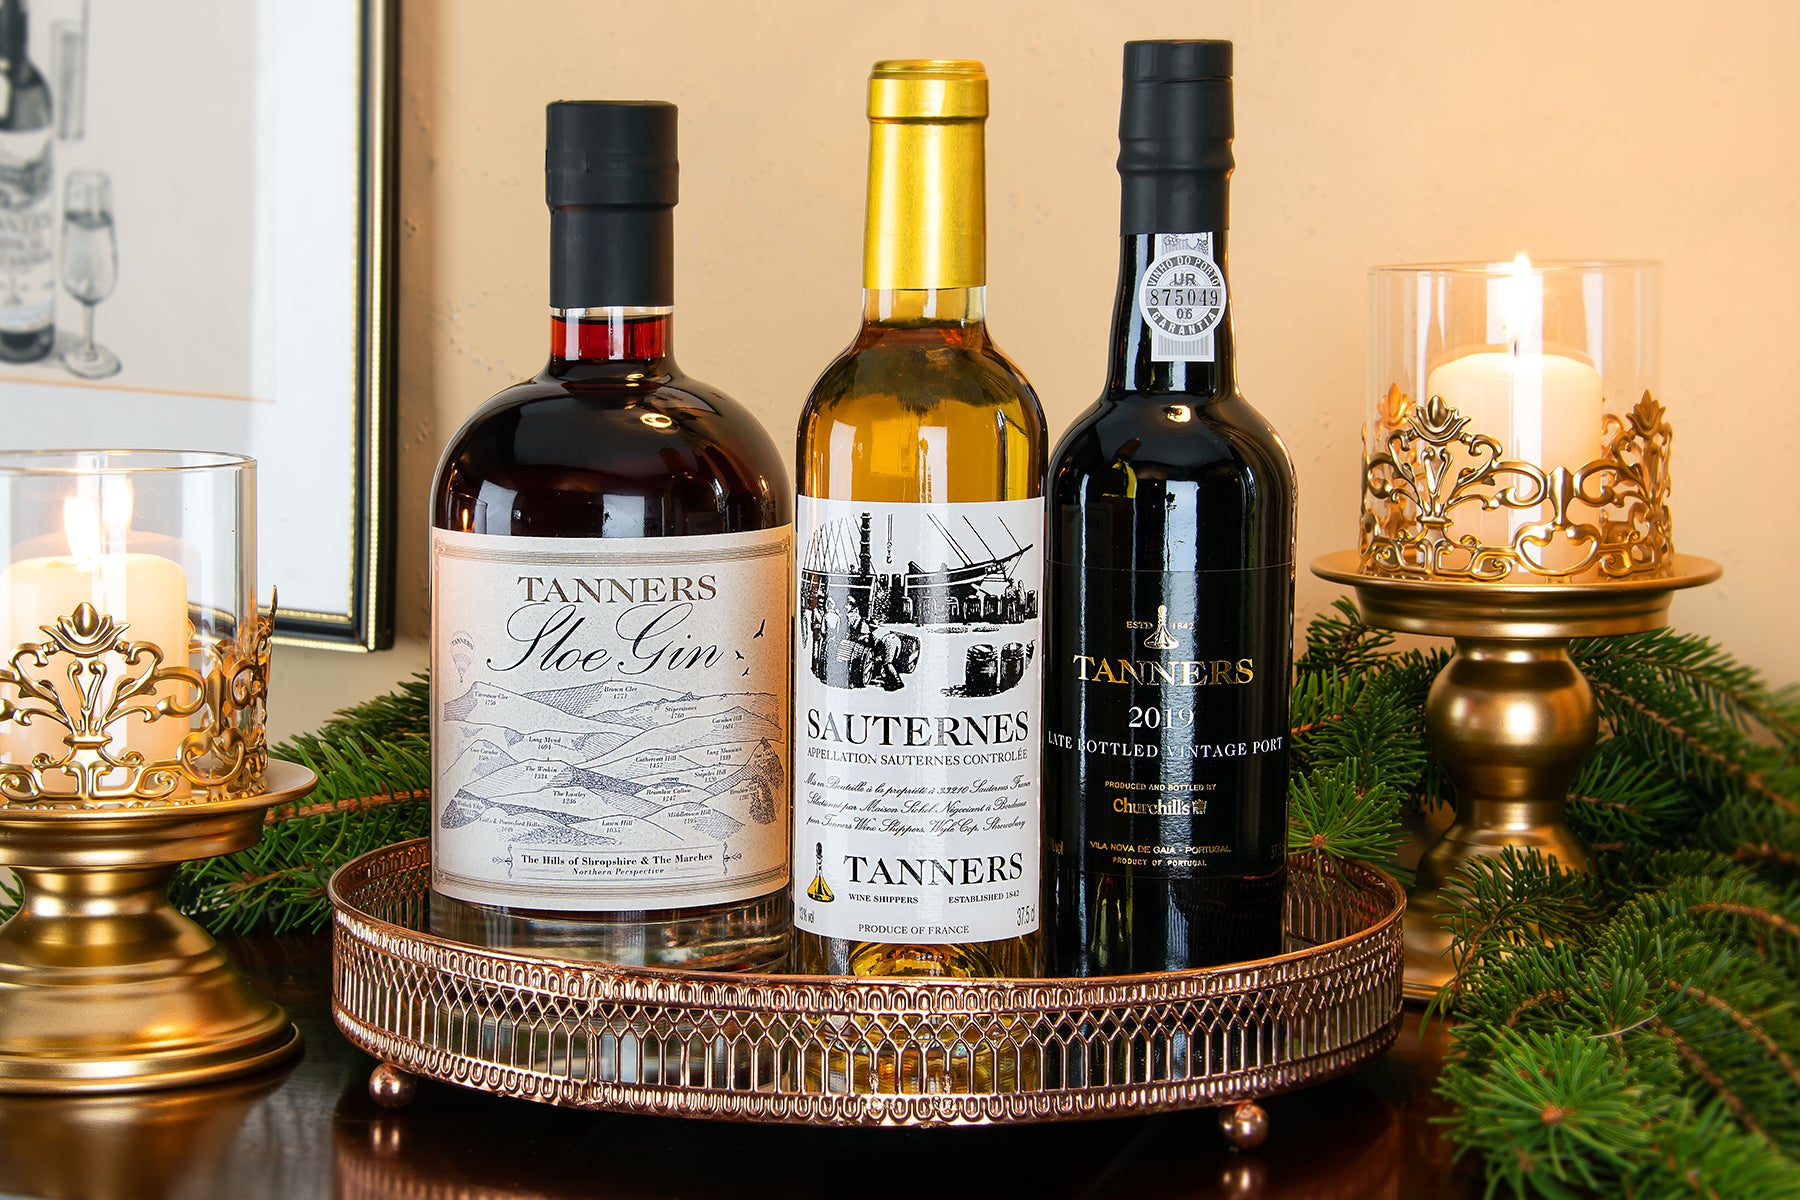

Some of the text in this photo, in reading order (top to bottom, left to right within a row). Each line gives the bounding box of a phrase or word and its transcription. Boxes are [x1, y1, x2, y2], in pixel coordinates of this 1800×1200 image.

[1147, 256, 1220, 286] VINHO DO PORTO
[1174, 273, 1196, 285] UR
[1150, 289, 1218, 306] 875049
[1152, 311, 1217, 335] GARANTIA
[517, 574, 717, 604] TANNERS
[1171, 622, 1195, 630] 1842
[486, 603, 724, 675] Sloe Gin
[1072, 654, 1254, 686] TANNERS
[1128, 706, 1194, 729] 2019
[807, 708, 1029, 746] SAUTERNES
[1048, 730, 1282, 758] LATE BOTTLED VINTAGE PORT
[807, 747, 1028, 766] APPELLATION SAUTERNES CONTROLÉE
[804, 772, 816, 786] Mis
[826, 776, 868, 792] Bouteille
[866, 785, 873, 793] à
[875, 782, 887, 793] la
[882, 786, 928, 798] propriété
[970, 779, 1008, 794] Sauternes
[1105, 781, 1147, 791] PRODUCED
[1149, 783, 1166, 791] AND
[1206, 783, 1217, 791] BY
[839, 803, 858, 813] par
[859, 799, 899, 812] Maison
[901, 800, 940, 814] Sichel
[935, 800, 985, 817] Négociant
[1113, 797, 1191, 816] Churchill's
[821, 814, 852, 829] Tanners
[854, 817, 877, 831] Wine
[1090, 841, 1108, 851] VILA
[1110, 843, 1135, 853] NOVA
[1137, 845, 1151, 854] DE
[1153, 846, 1177, 854] GAIA
[1185, 845, 1232, 854] PORTUGAL
[521, 853, 713, 868] The Hills of Shropshire & The Marches
[842, 852, 1023, 886] TANNERS
[1112, 857, 1208, 867] PRODUCT OF PORTUGAL
[572, 867, 664, 878] Northern Perspective
[848, 893, 919, 904] WINE SHIPPERS
[948, 890, 1020, 904] ESTABLISHED 1842
[859, 924, 969, 935] PRODUCE OF FRANCE
